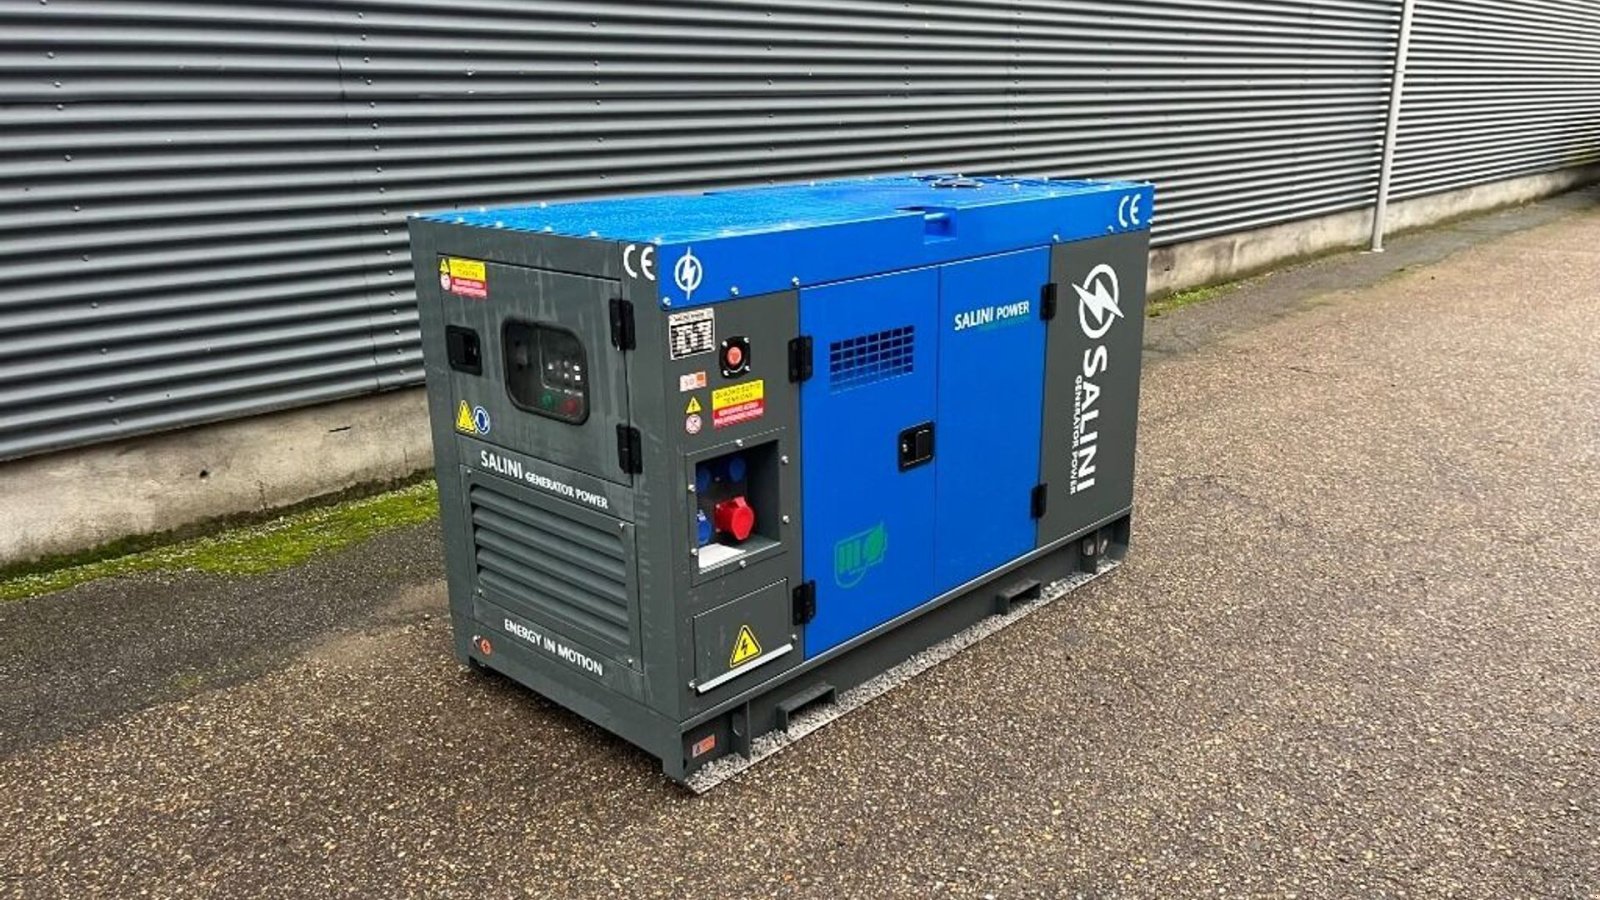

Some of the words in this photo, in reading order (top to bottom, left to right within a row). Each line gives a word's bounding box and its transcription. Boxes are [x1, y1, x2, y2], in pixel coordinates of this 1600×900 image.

[1118, 193, 1141, 228] CE
[623, 244, 656, 280] CE
[954, 306, 994, 331] SALINI
[996, 300, 1030, 320] POWER
[1071, 374, 1083, 449] GENERATOR
[1076, 345, 1108, 493] SALINI
[480, 449, 523, 479] SALINI
[525, 471, 575, 498] GENERATOR
[575, 488, 609, 509] POWER
[1069, 450, 1078, 495] POWER
[504, 618, 542, 646] ENERGY
[543, 636, 556, 654] IN
[557, 643, 603, 676] MOTION
